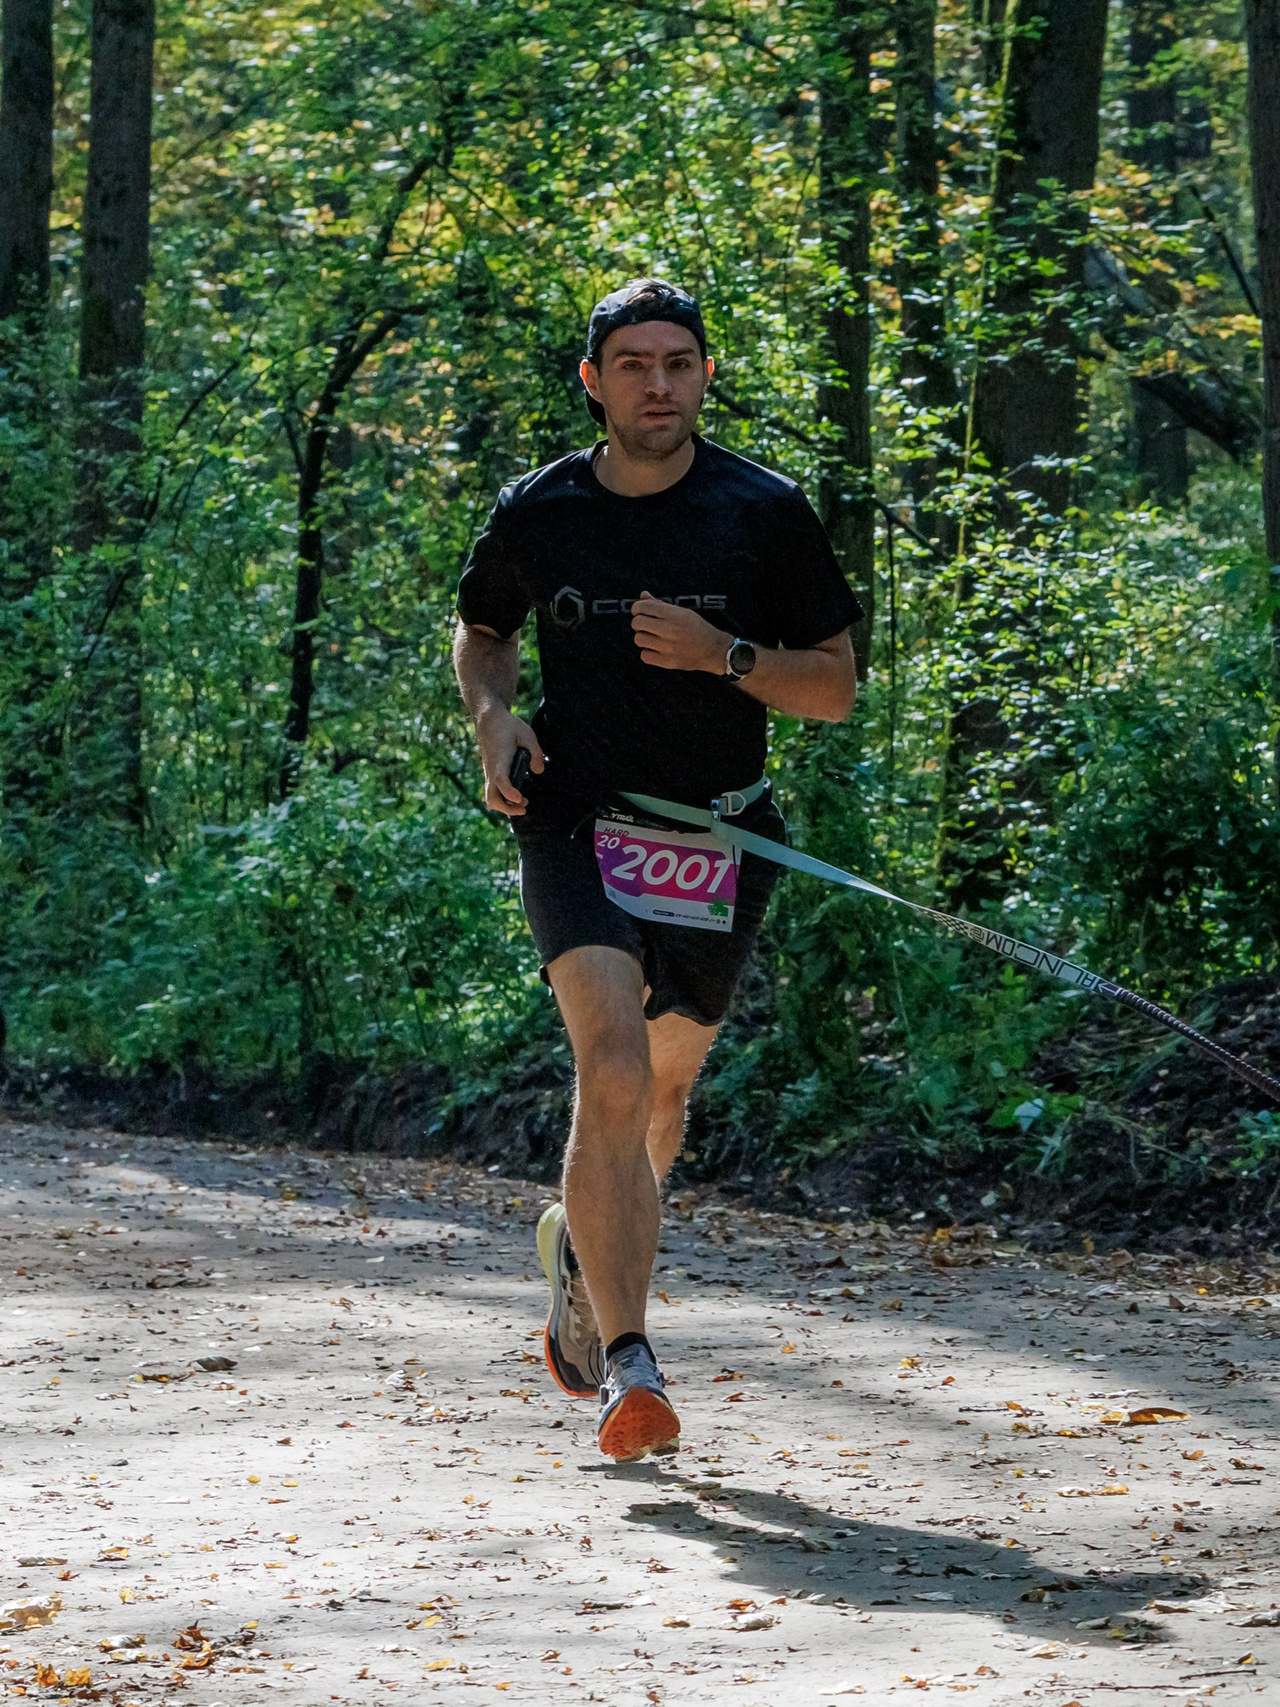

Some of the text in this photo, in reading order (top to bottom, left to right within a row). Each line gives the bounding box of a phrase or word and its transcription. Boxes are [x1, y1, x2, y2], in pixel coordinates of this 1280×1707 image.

[592, 595, 727, 614] COOS
[604, 827, 630, 836] HARD
[597, 834, 621, 849] 20
[611, 844, 730, 893] 2001
